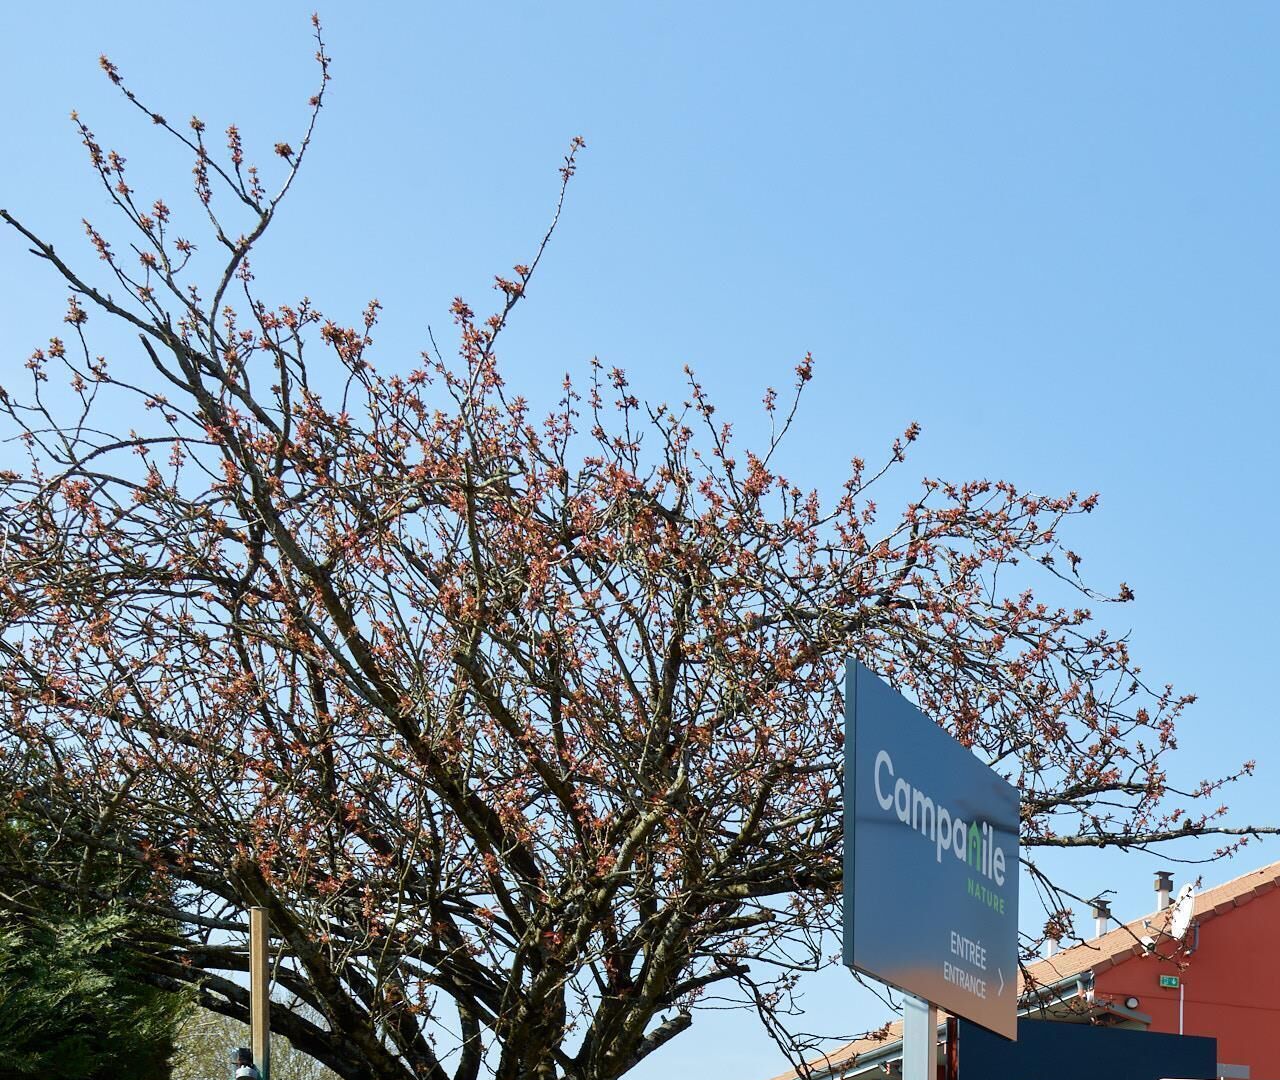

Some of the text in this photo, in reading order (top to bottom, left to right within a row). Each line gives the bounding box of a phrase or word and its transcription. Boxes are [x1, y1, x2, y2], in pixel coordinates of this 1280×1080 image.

[874, 750, 1006, 887] Campanile
[967, 878, 1005, 914] NATURE
[950, 930, 987, 971] ENTRÉE
[943, 960, 987, 1000] ENTRANCE
